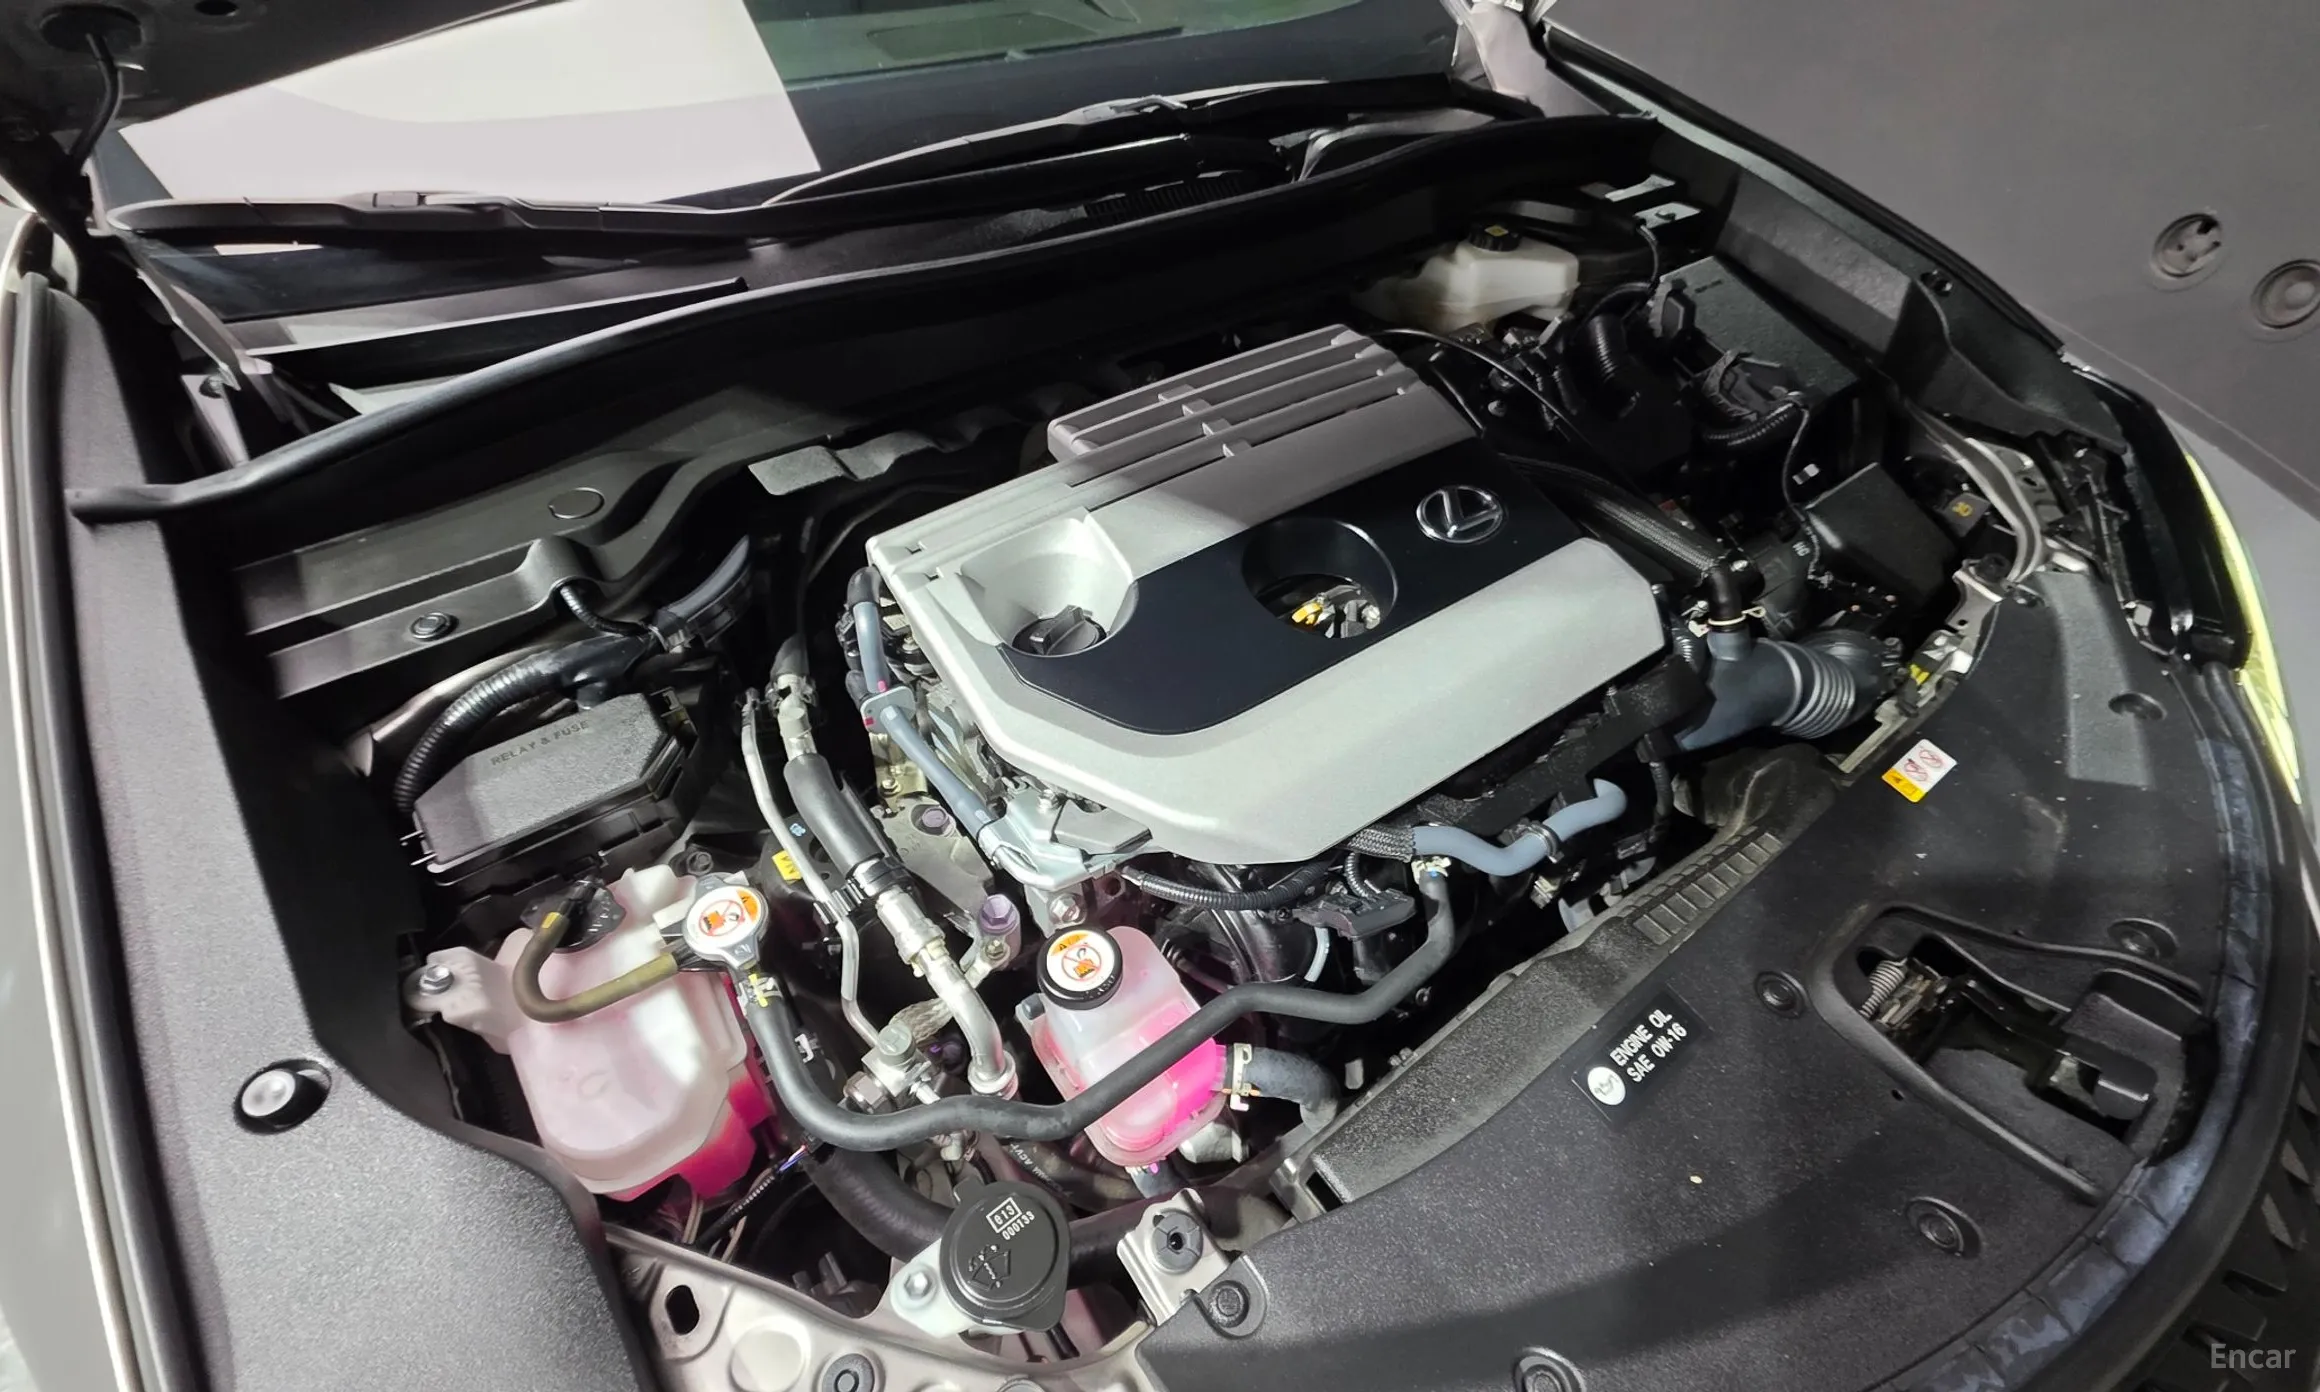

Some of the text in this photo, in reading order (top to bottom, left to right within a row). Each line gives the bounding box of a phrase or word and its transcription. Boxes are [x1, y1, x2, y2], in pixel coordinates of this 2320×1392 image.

[490, 720, 590, 766] RELAY & FUSE
[1610, 1009, 1672, 1067] ENGINE OIL
[1627, 1054, 1655, 1082] SAE
[1002, 1210, 1035, 1240] 000133
